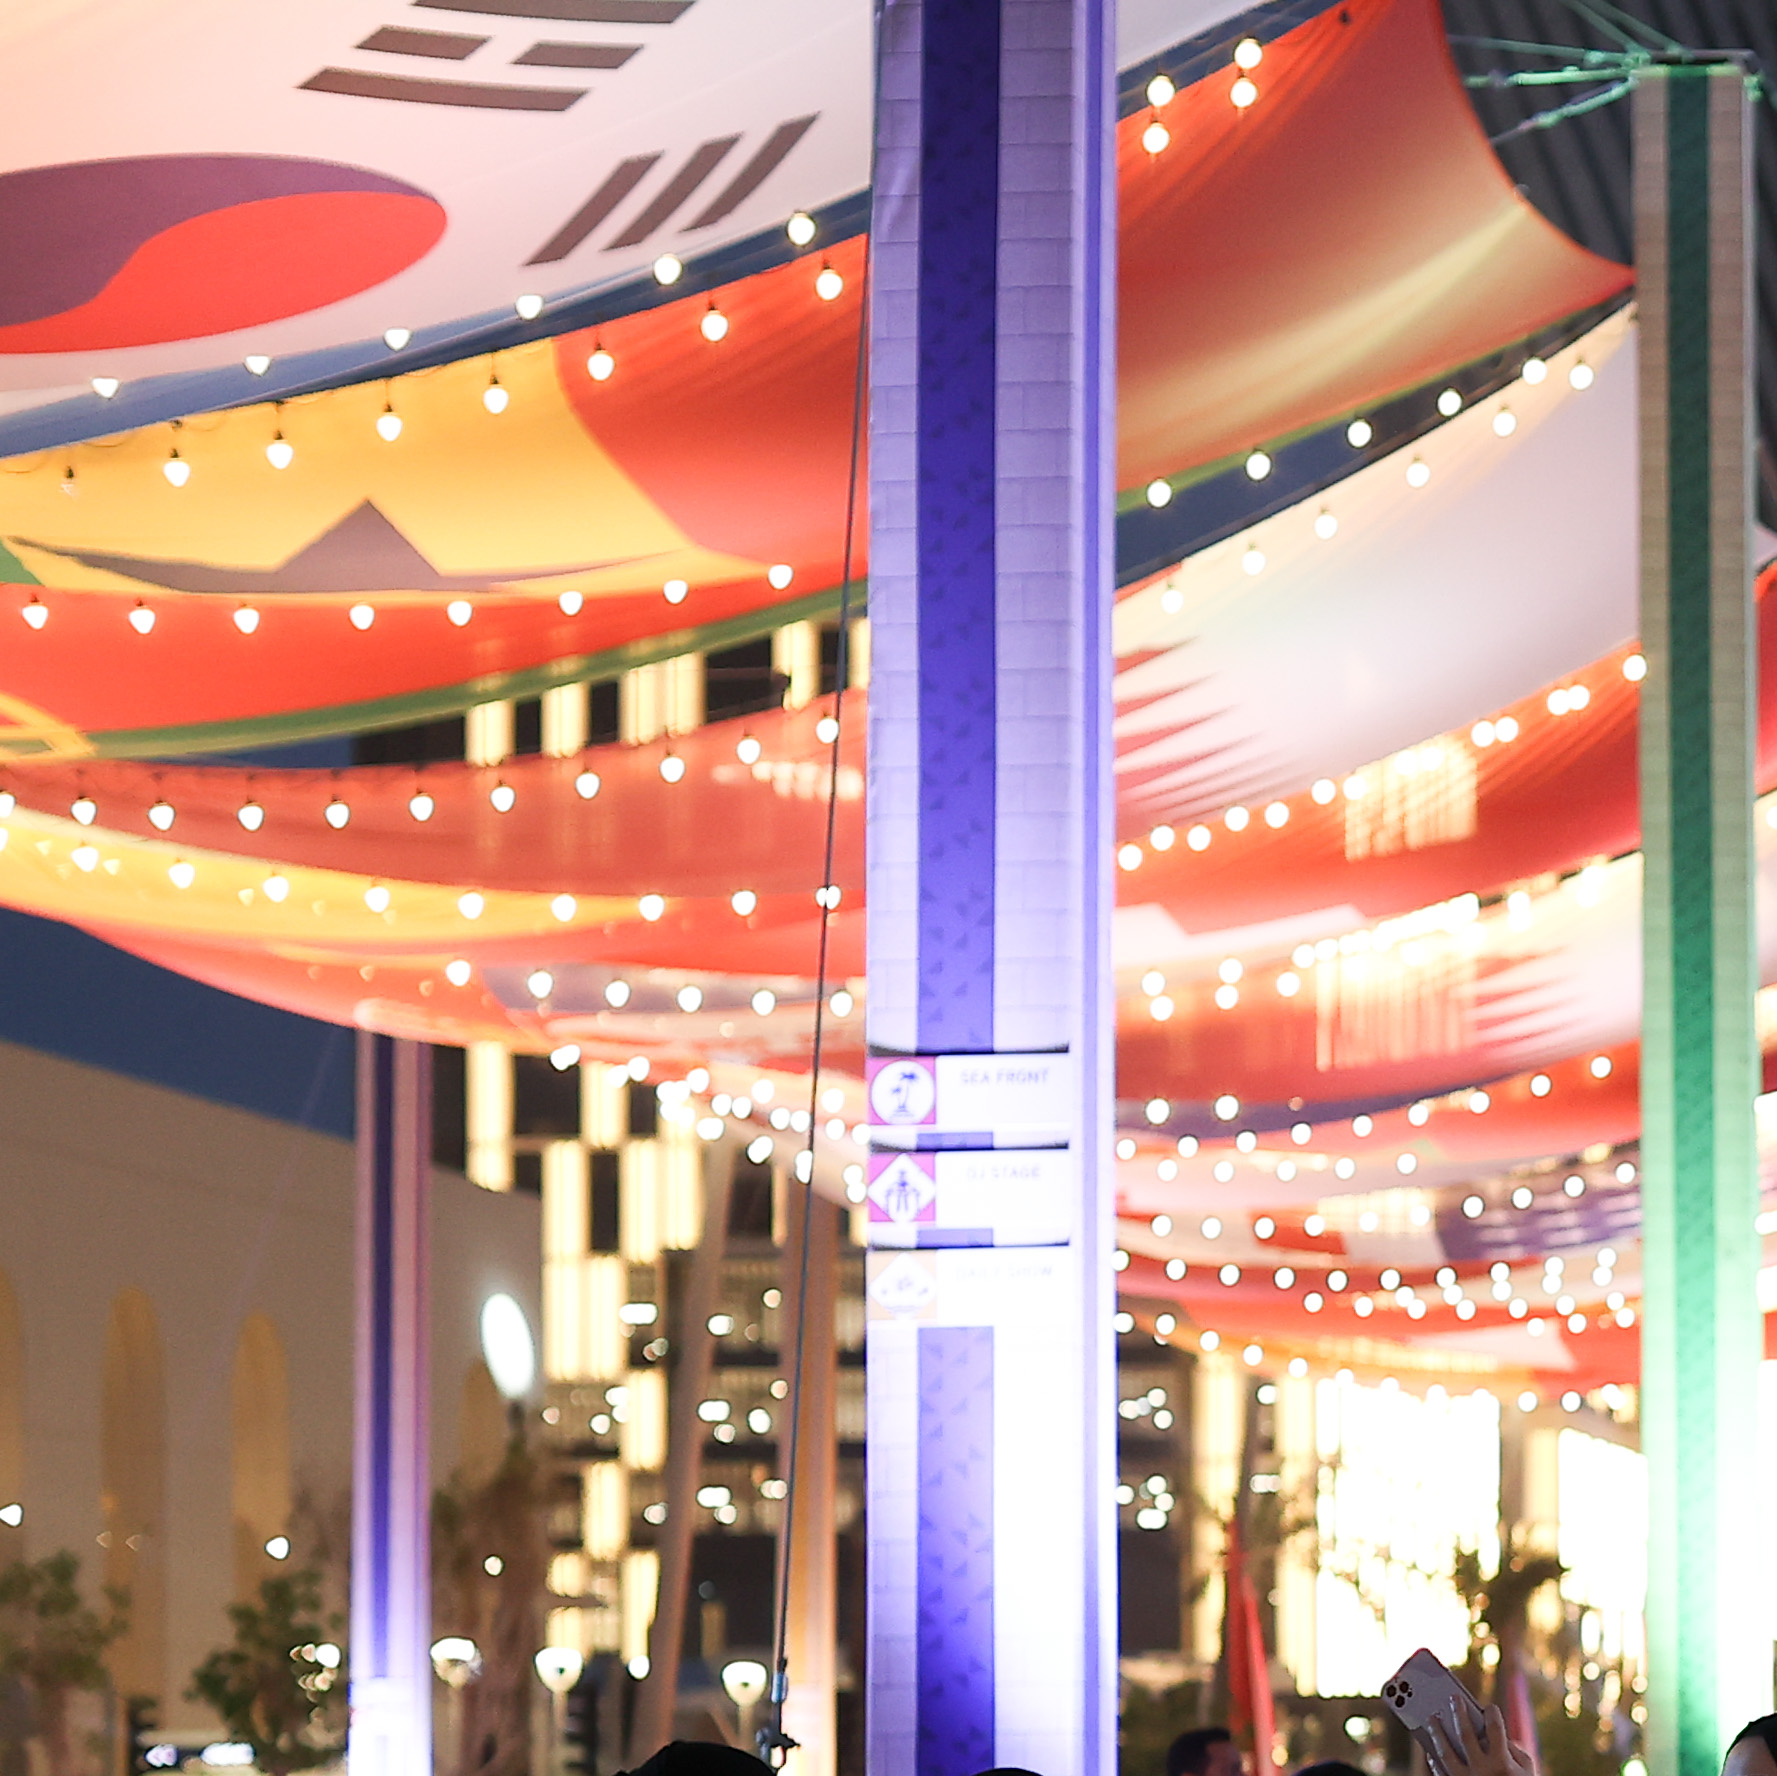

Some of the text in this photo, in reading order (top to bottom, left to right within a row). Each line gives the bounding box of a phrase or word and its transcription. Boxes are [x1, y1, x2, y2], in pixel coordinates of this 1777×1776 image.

[960, 1066, 1051, 1086] SEA FRONT
[990, 1163, 1041, 1180] STAGE
